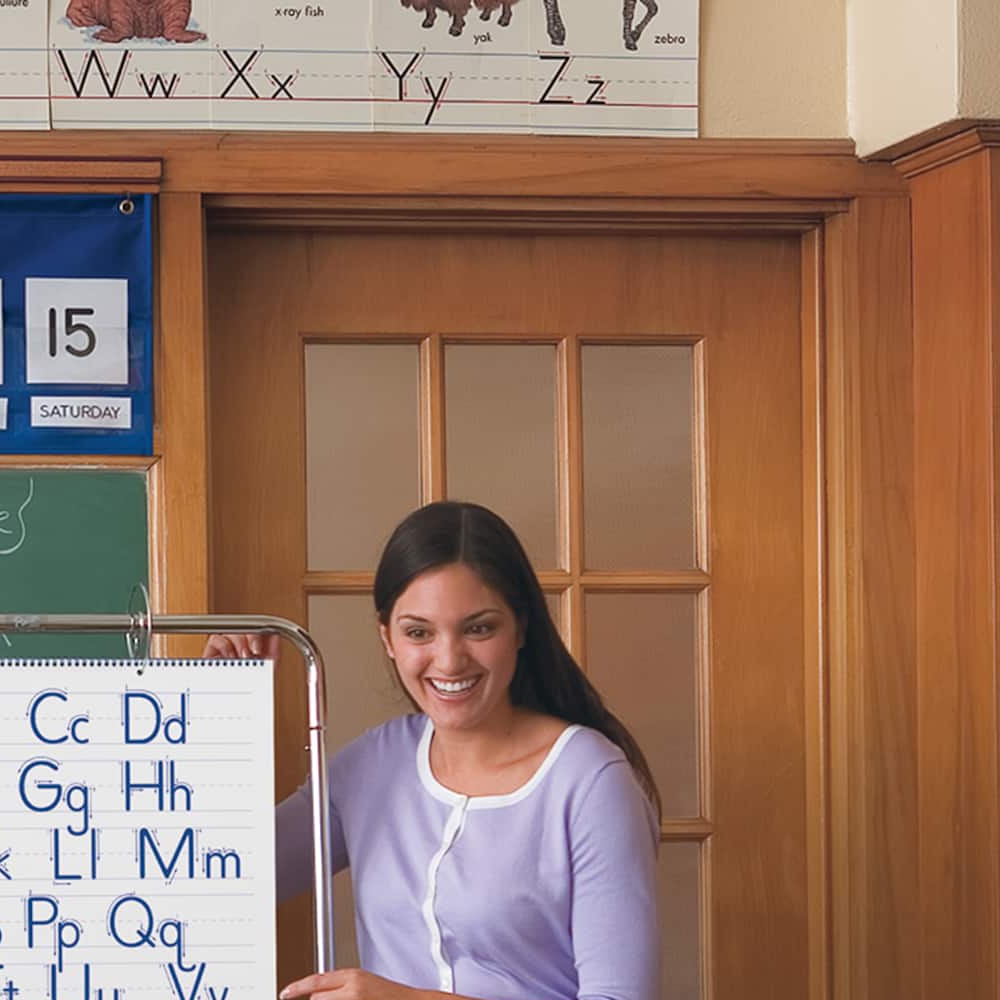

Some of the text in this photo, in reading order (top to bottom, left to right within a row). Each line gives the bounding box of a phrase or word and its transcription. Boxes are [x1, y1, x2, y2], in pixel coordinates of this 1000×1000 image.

[305, 5, 325, 18] fish
[473, 31, 493, 45] yak
[654, 33, 686, 45] zebra
[49, 308, 96, 357] 15
[40, 404, 120, 419] SATURDAY
[29, 692, 90, 743] Cc
[123, 693, 187, 743] Dd
[18, 760, 89, 836] Gg
[124, 760, 191, 811] Hh
[139, 828, 242, 879] Mm
[27, 897, 81, 972] Pp
[109, 896, 197, 971] Qq
